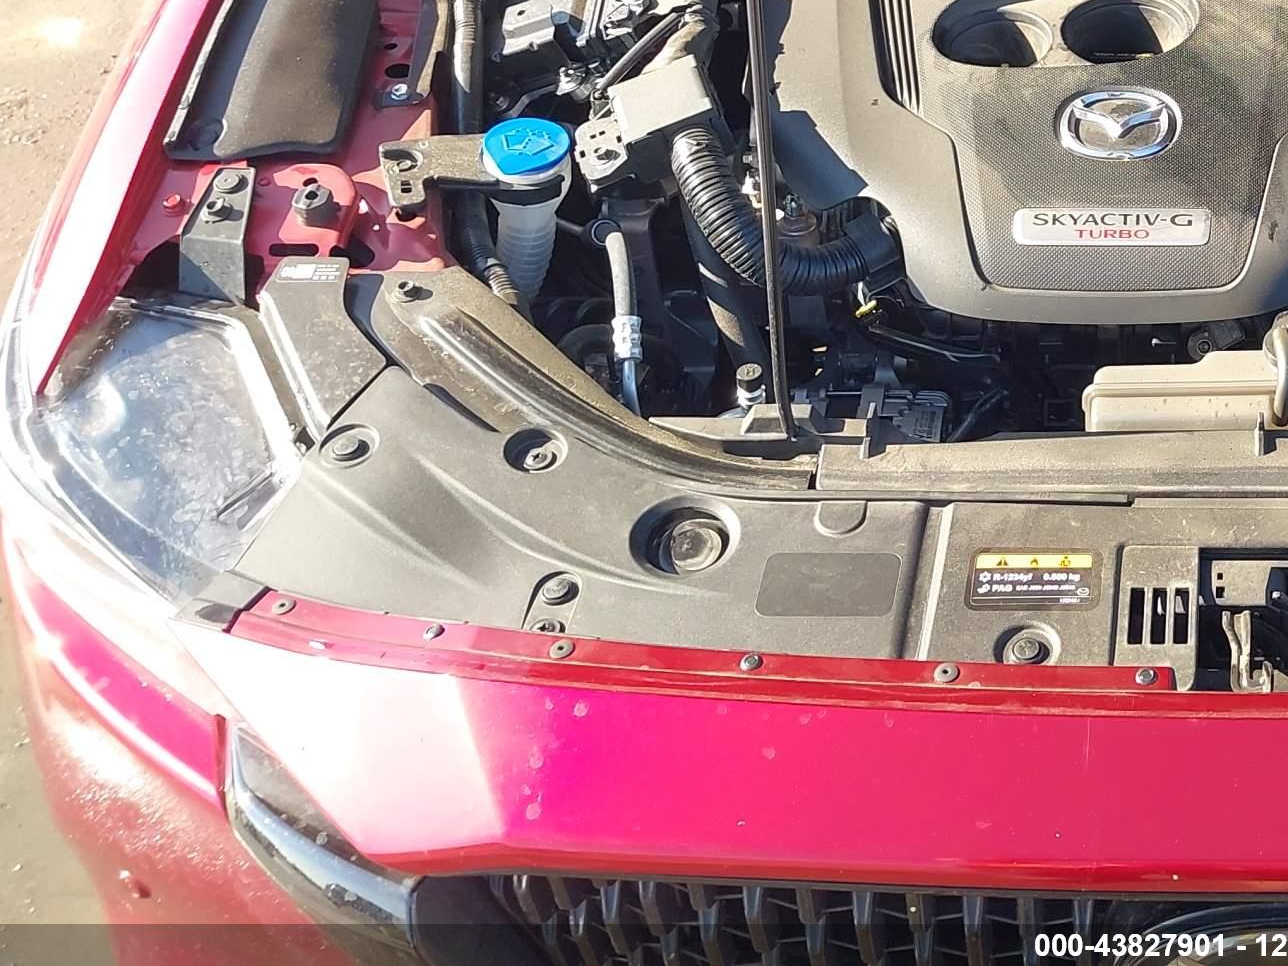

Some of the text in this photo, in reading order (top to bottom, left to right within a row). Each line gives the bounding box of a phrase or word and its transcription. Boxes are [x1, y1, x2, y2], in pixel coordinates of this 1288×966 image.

[1032, 213, 1193, 227] SKYACTIV-G
[1075, 229, 1150, 239] TURBO
[992, 584, 1013, 593] PAG
